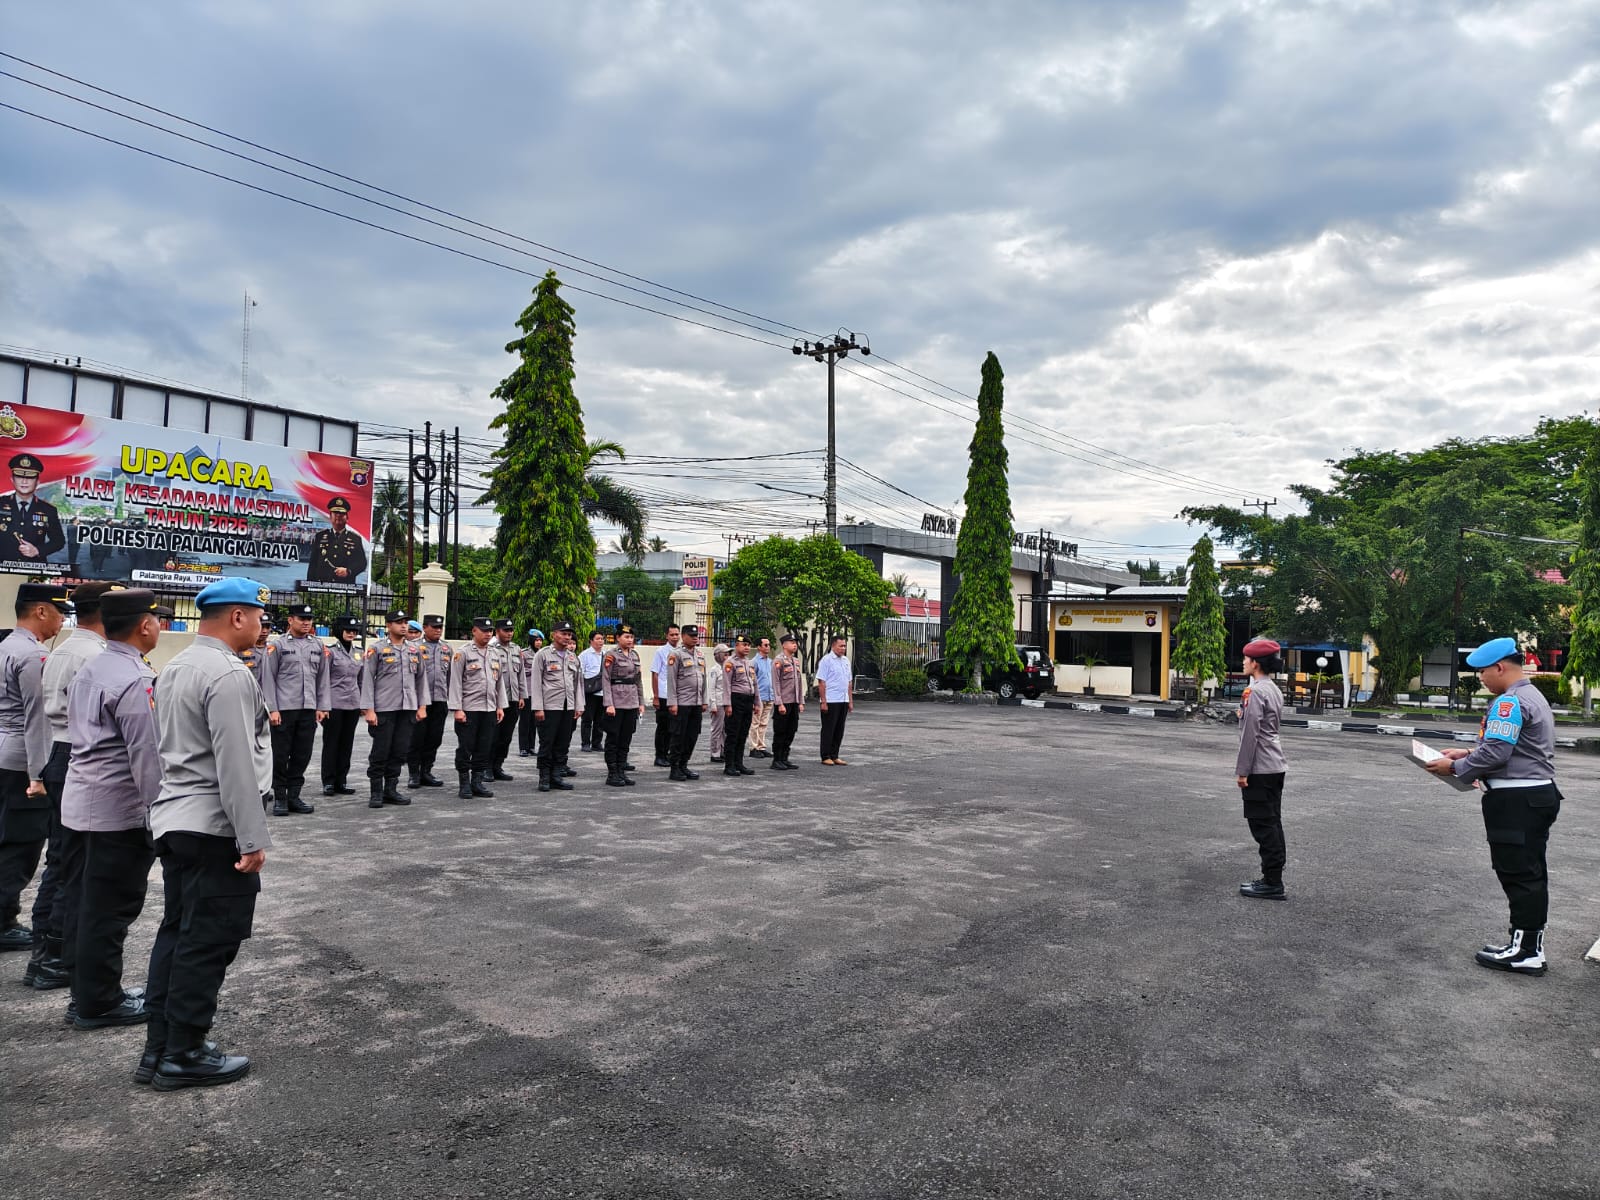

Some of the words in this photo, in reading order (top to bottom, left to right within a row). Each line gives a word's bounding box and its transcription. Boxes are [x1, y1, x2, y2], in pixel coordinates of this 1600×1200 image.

[121, 445, 273, 491] UPACARA
[65, 475, 115, 501] HARI
[124, 483, 230, 513] KESADARAN
[234, 495, 313, 523] NASIONAL
[145, 507, 205, 533] TAHUN
[208, 514, 248, 536] 2026
[77, 525, 167, 550] POLRESTA
[170, 533, 257, 557] PALANGKA
[261, 541, 299, 562] RAYA
[139, 571, 172, 582] Palangka
[684, 561, 707, 569] POLISI
